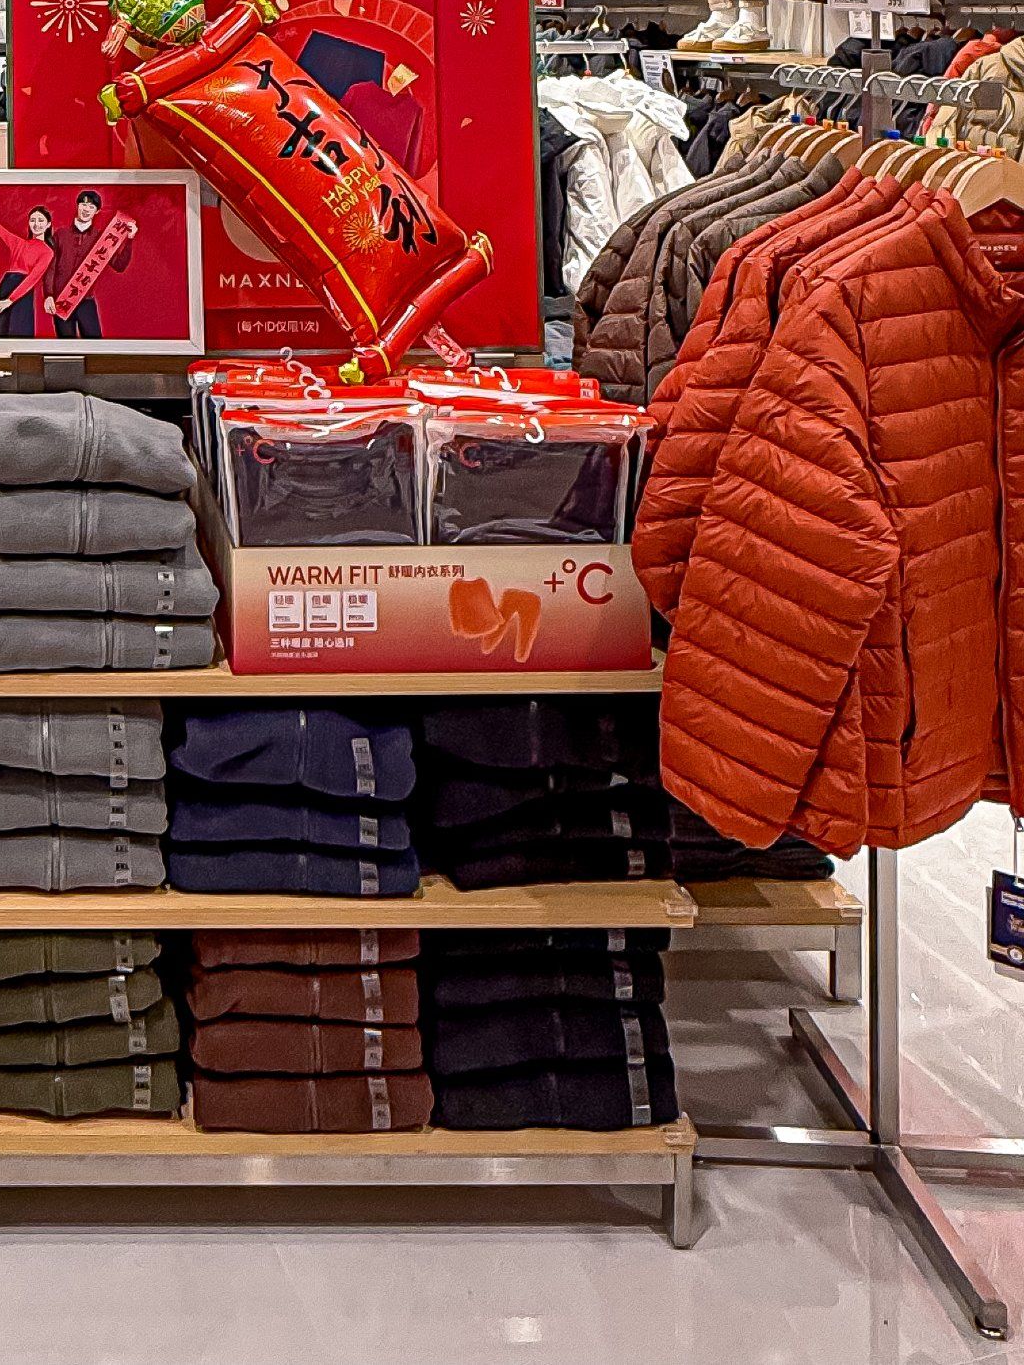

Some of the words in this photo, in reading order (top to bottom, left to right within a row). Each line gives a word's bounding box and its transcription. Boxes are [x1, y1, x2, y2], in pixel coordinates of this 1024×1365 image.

[322, 162, 372, 209] HAPPY
[332, 192, 360, 218] new
[358, 175, 382, 202] year
[267, 565, 343, 585] WARM
[349, 565, 384, 585] FIT
